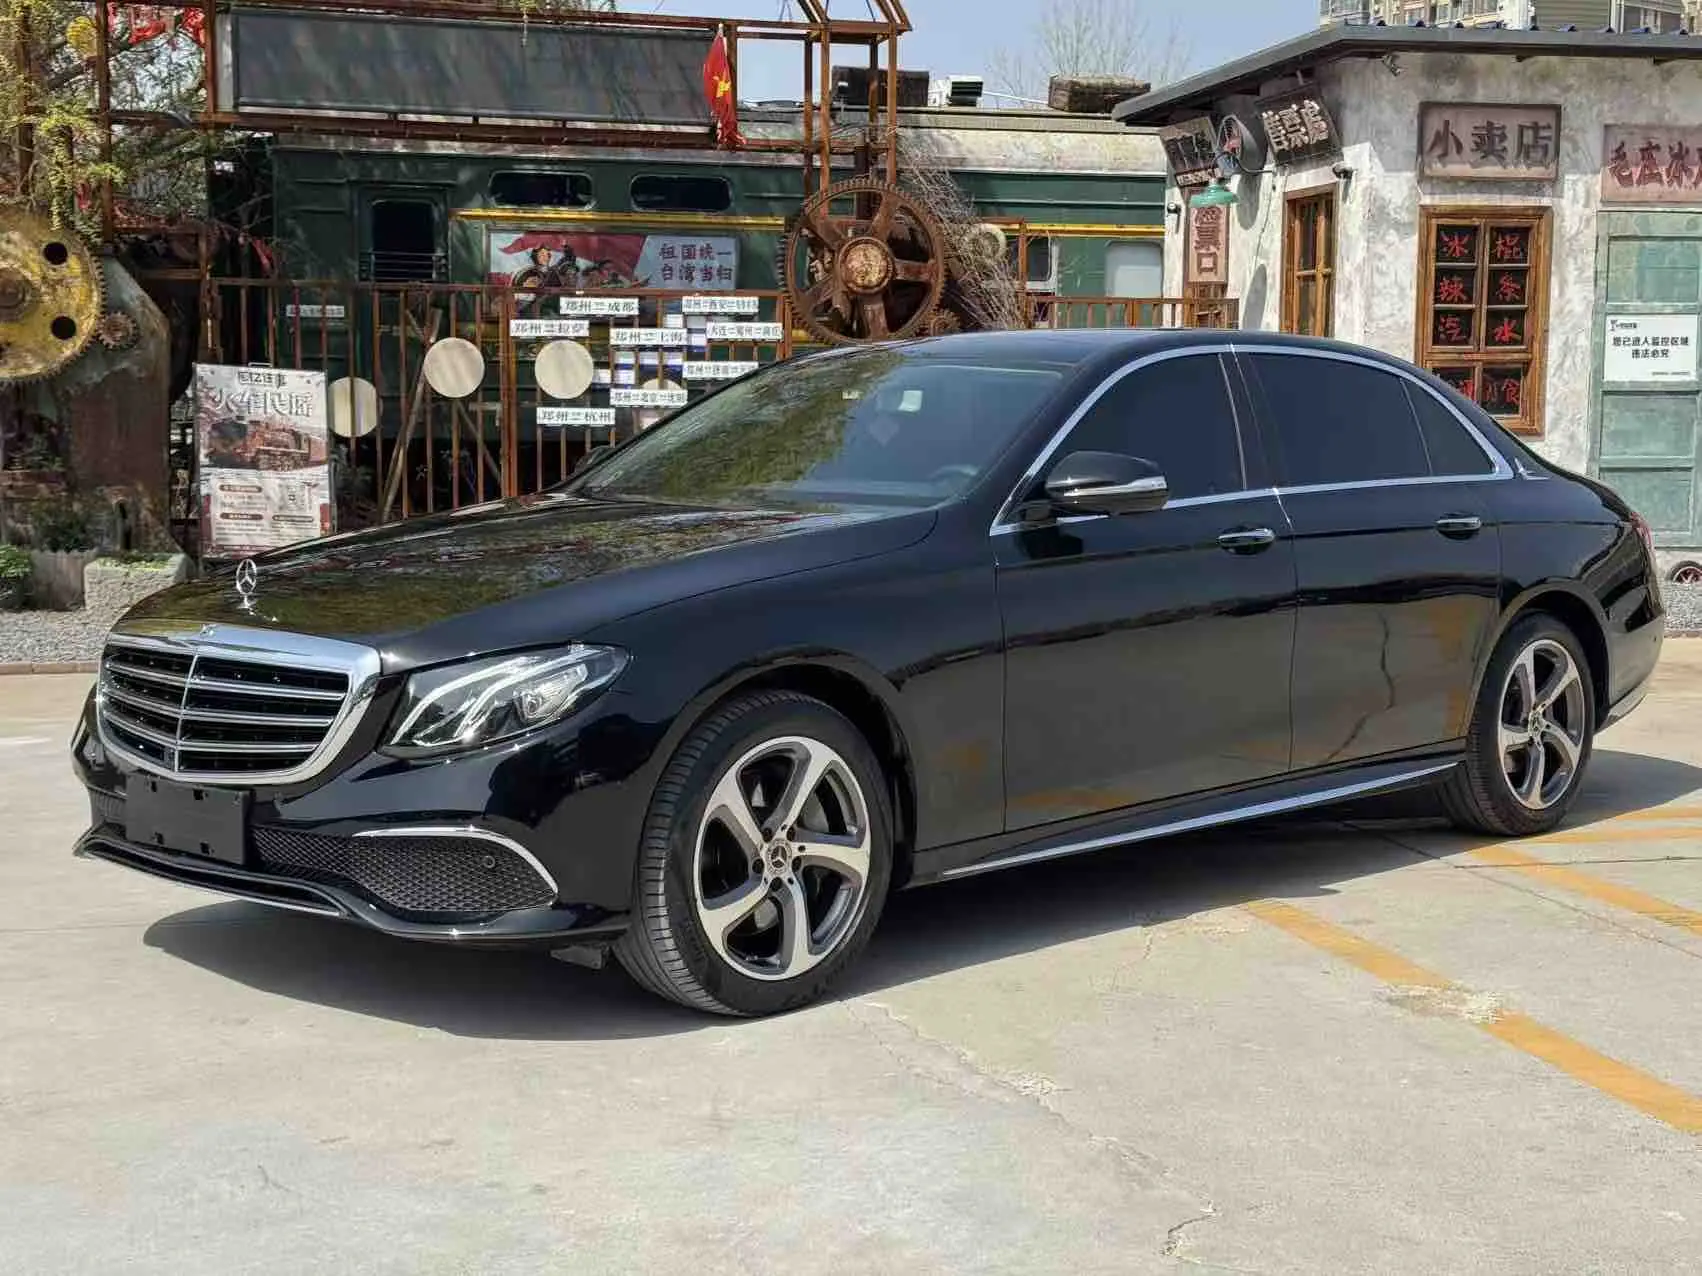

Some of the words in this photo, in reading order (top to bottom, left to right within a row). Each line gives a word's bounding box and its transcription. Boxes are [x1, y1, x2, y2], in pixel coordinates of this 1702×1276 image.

[1427, 118, 1553, 163] 小卖店
[1631, 349, 1669, 359] 违法必究
